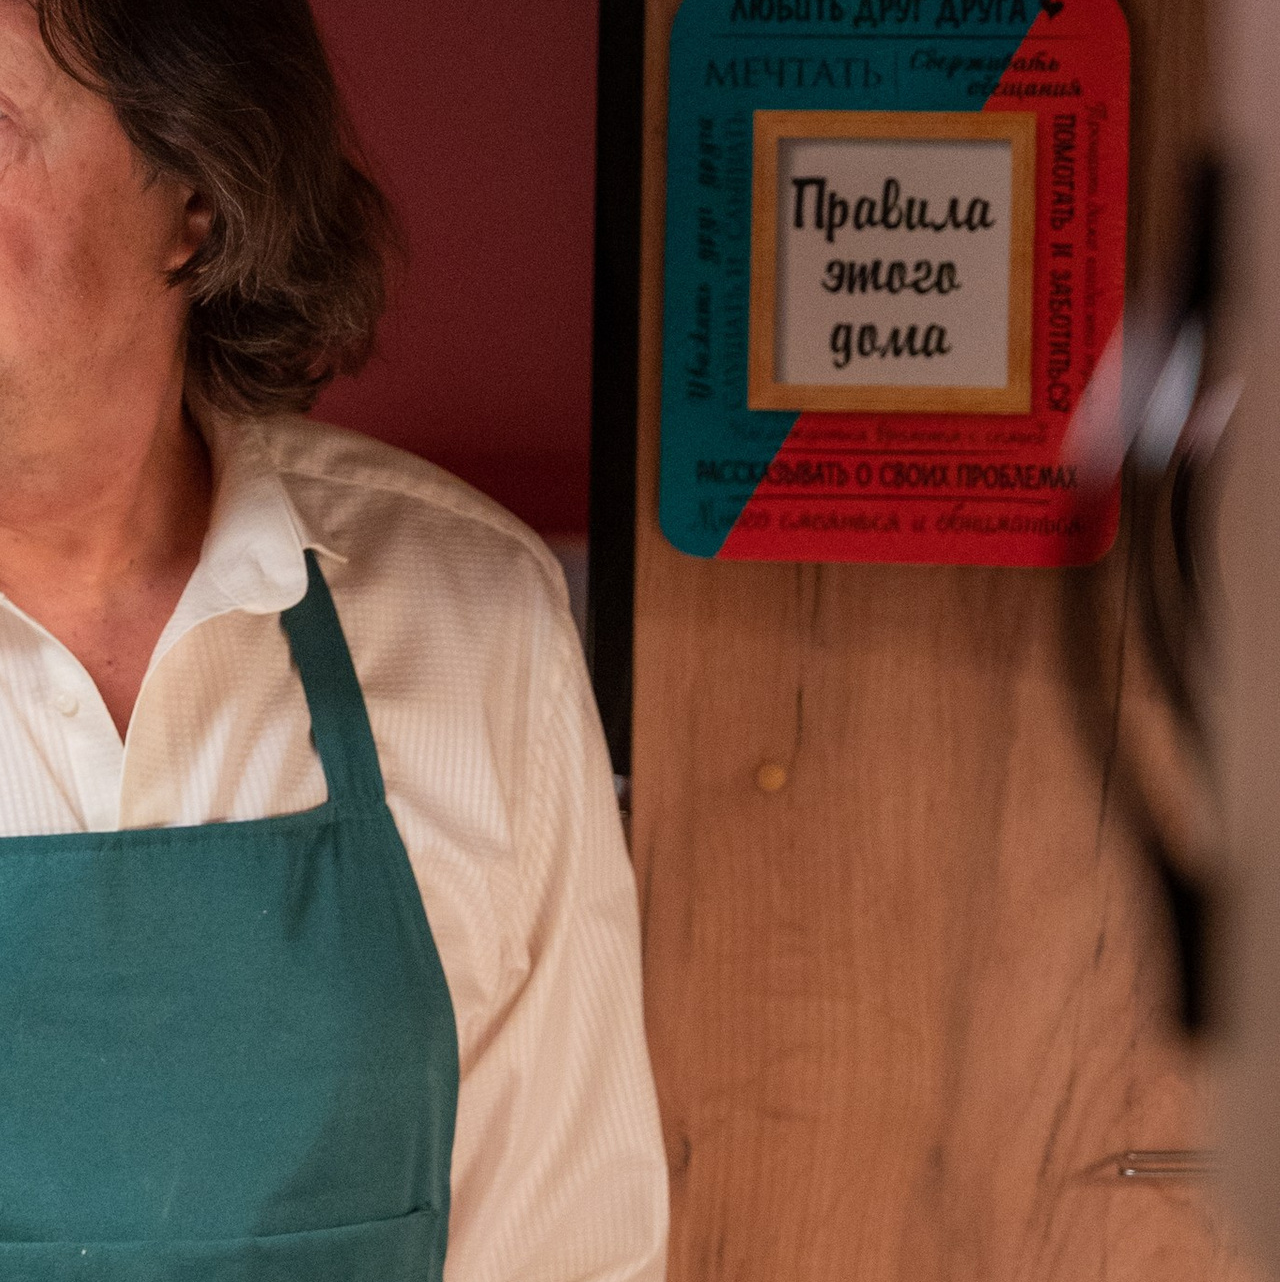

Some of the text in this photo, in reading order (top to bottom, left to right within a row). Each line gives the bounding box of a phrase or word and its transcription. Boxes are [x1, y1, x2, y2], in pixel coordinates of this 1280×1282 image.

[704, 56, 883, 90] МЕЧТАТЬ
[909, 48, 1061, 78] Сдерживать
[967, 74, 1083, 99] обещания
[791, 176, 994, 242] Правила
[822, 258, 962, 296] этого
[1046, 112, 1076, 415] ПОМОГАТЬ И ЗАБОТИТЬСЯ
[830, 321, 952, 369] дома
[695, 459, 1078, 492] РАССКАЗЫВАТЬ О СВОИХ ПРОБЛЕМАХ
